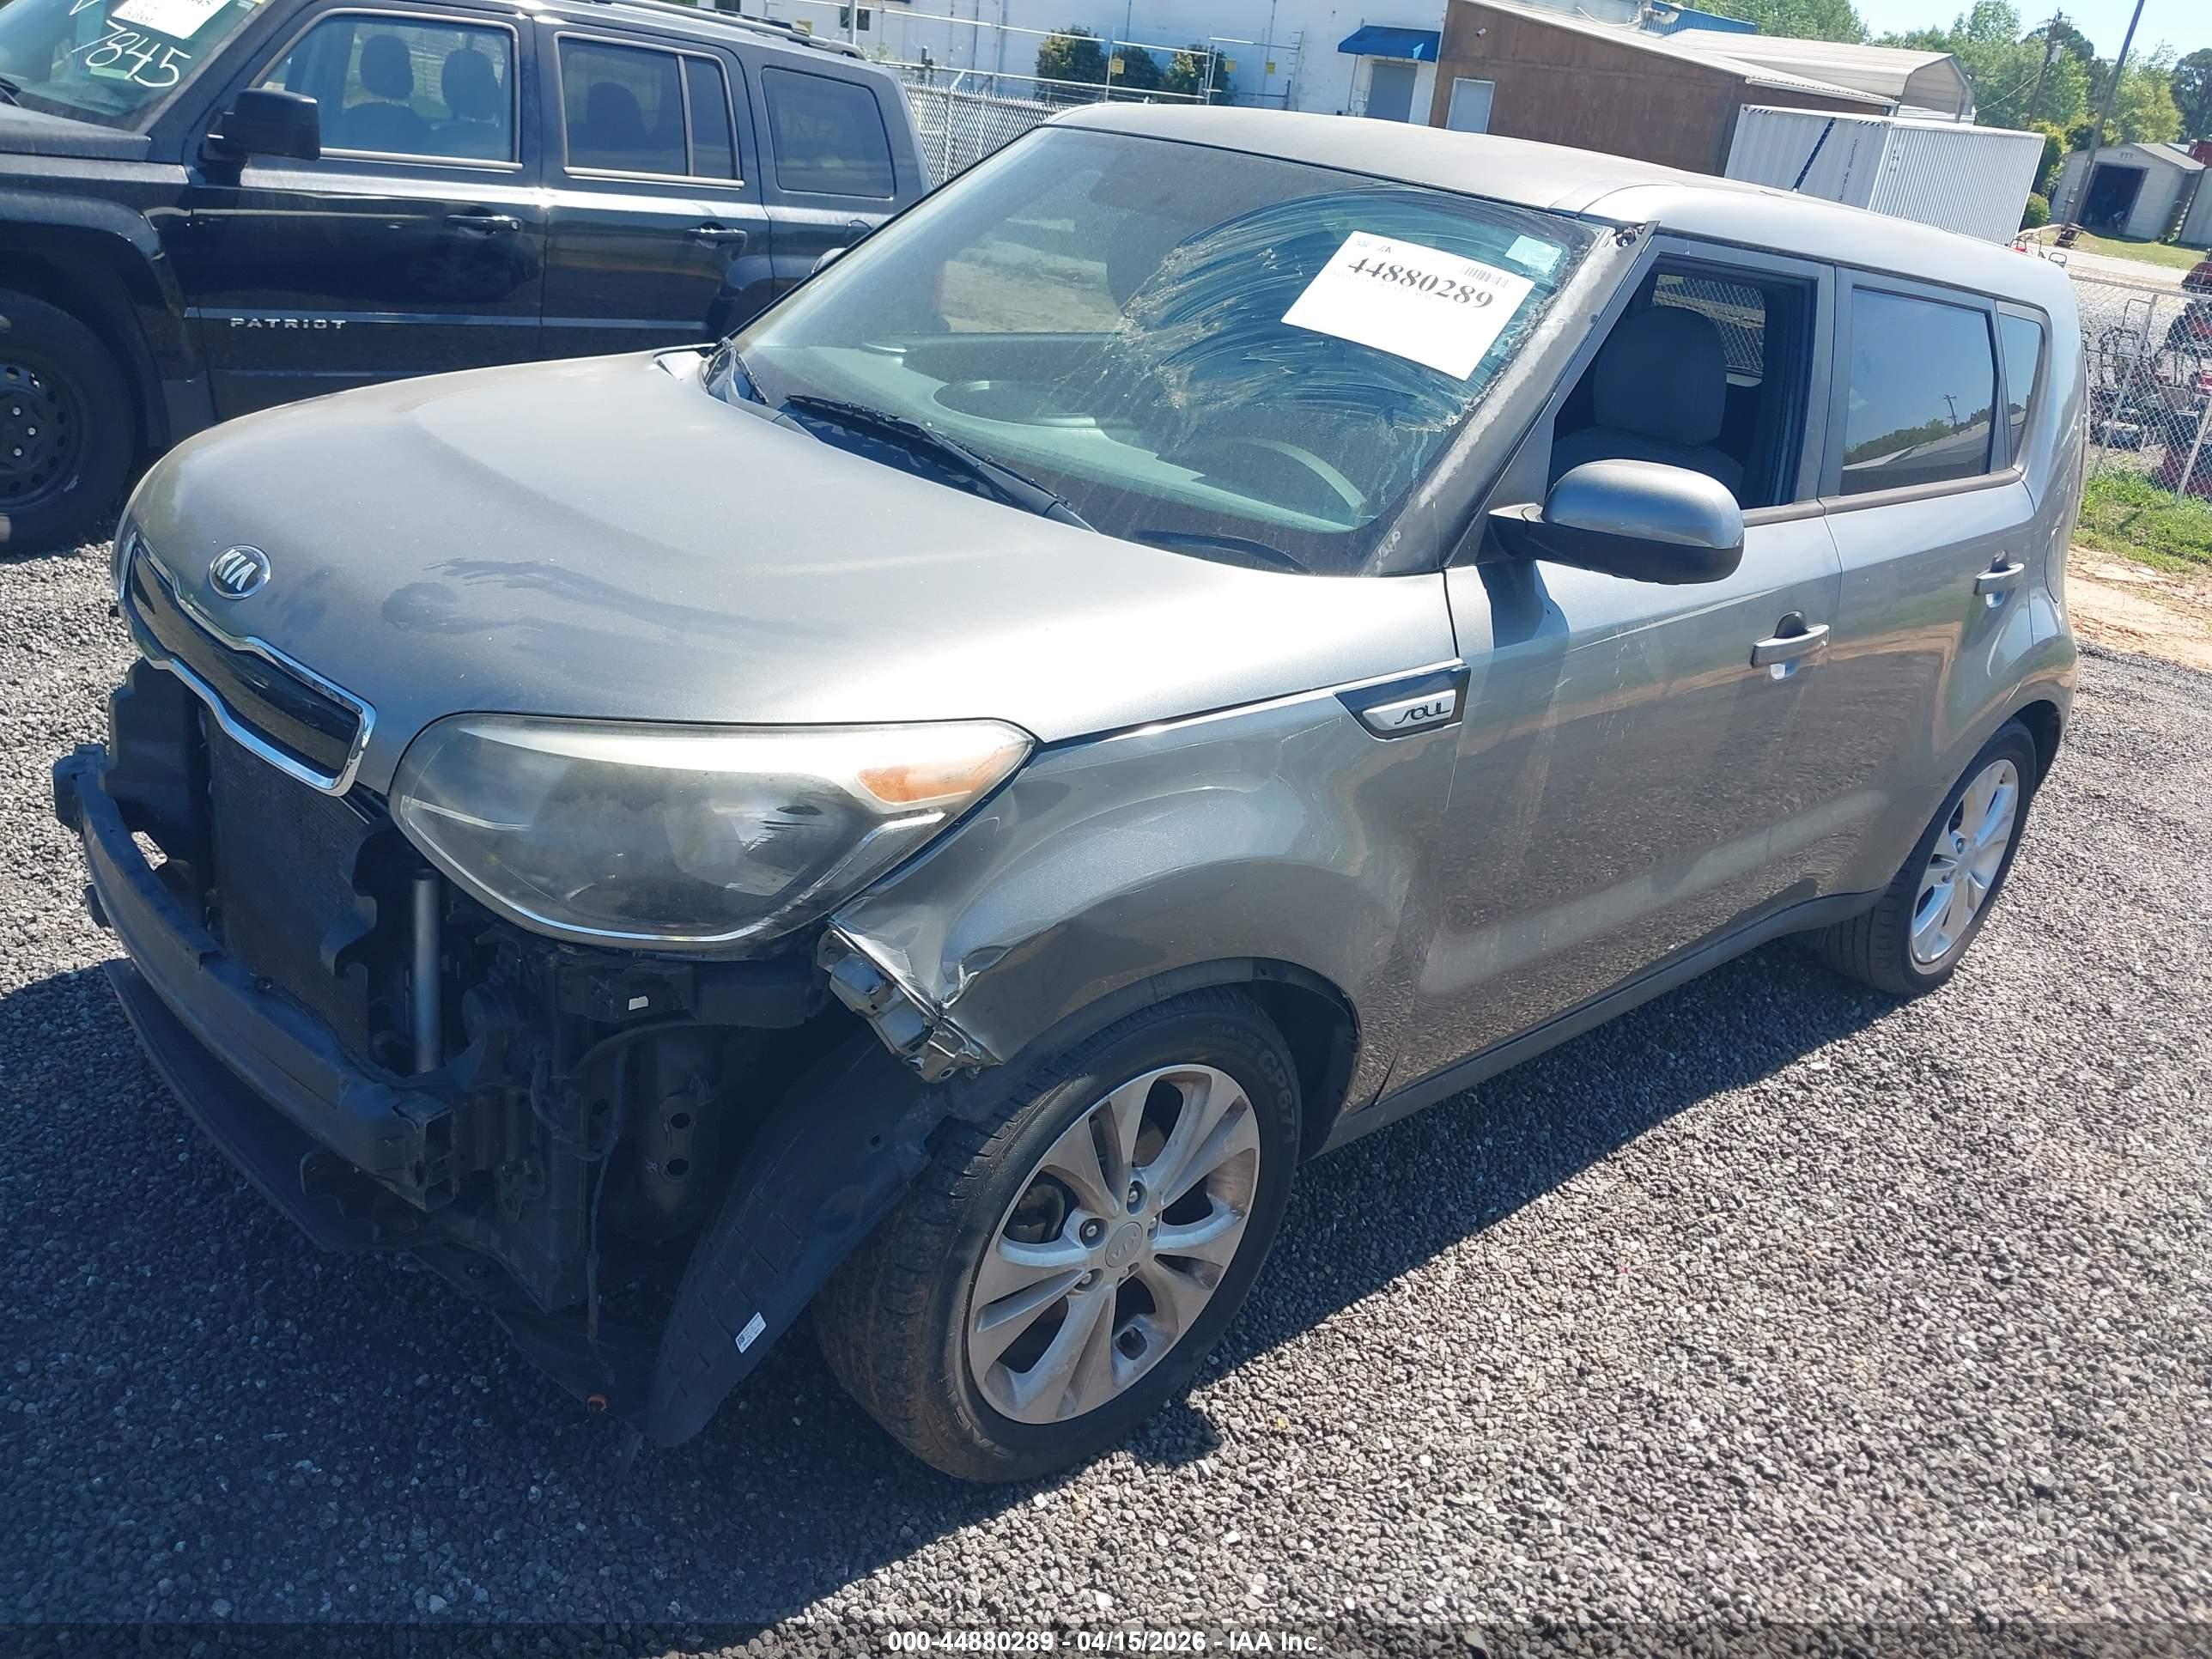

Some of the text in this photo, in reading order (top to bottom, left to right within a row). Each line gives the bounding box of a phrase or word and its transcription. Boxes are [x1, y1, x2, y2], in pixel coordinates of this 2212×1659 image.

[70, 19, 191, 88] 7845
[1348, 258, 1493, 308] 44880289
[229, 317, 347, 330] PATRIOT
[212, 548, 258, 592] KIA
[1394, 701, 1451, 726] SOUL
[1258, 1048, 1297, 1144] CP671
